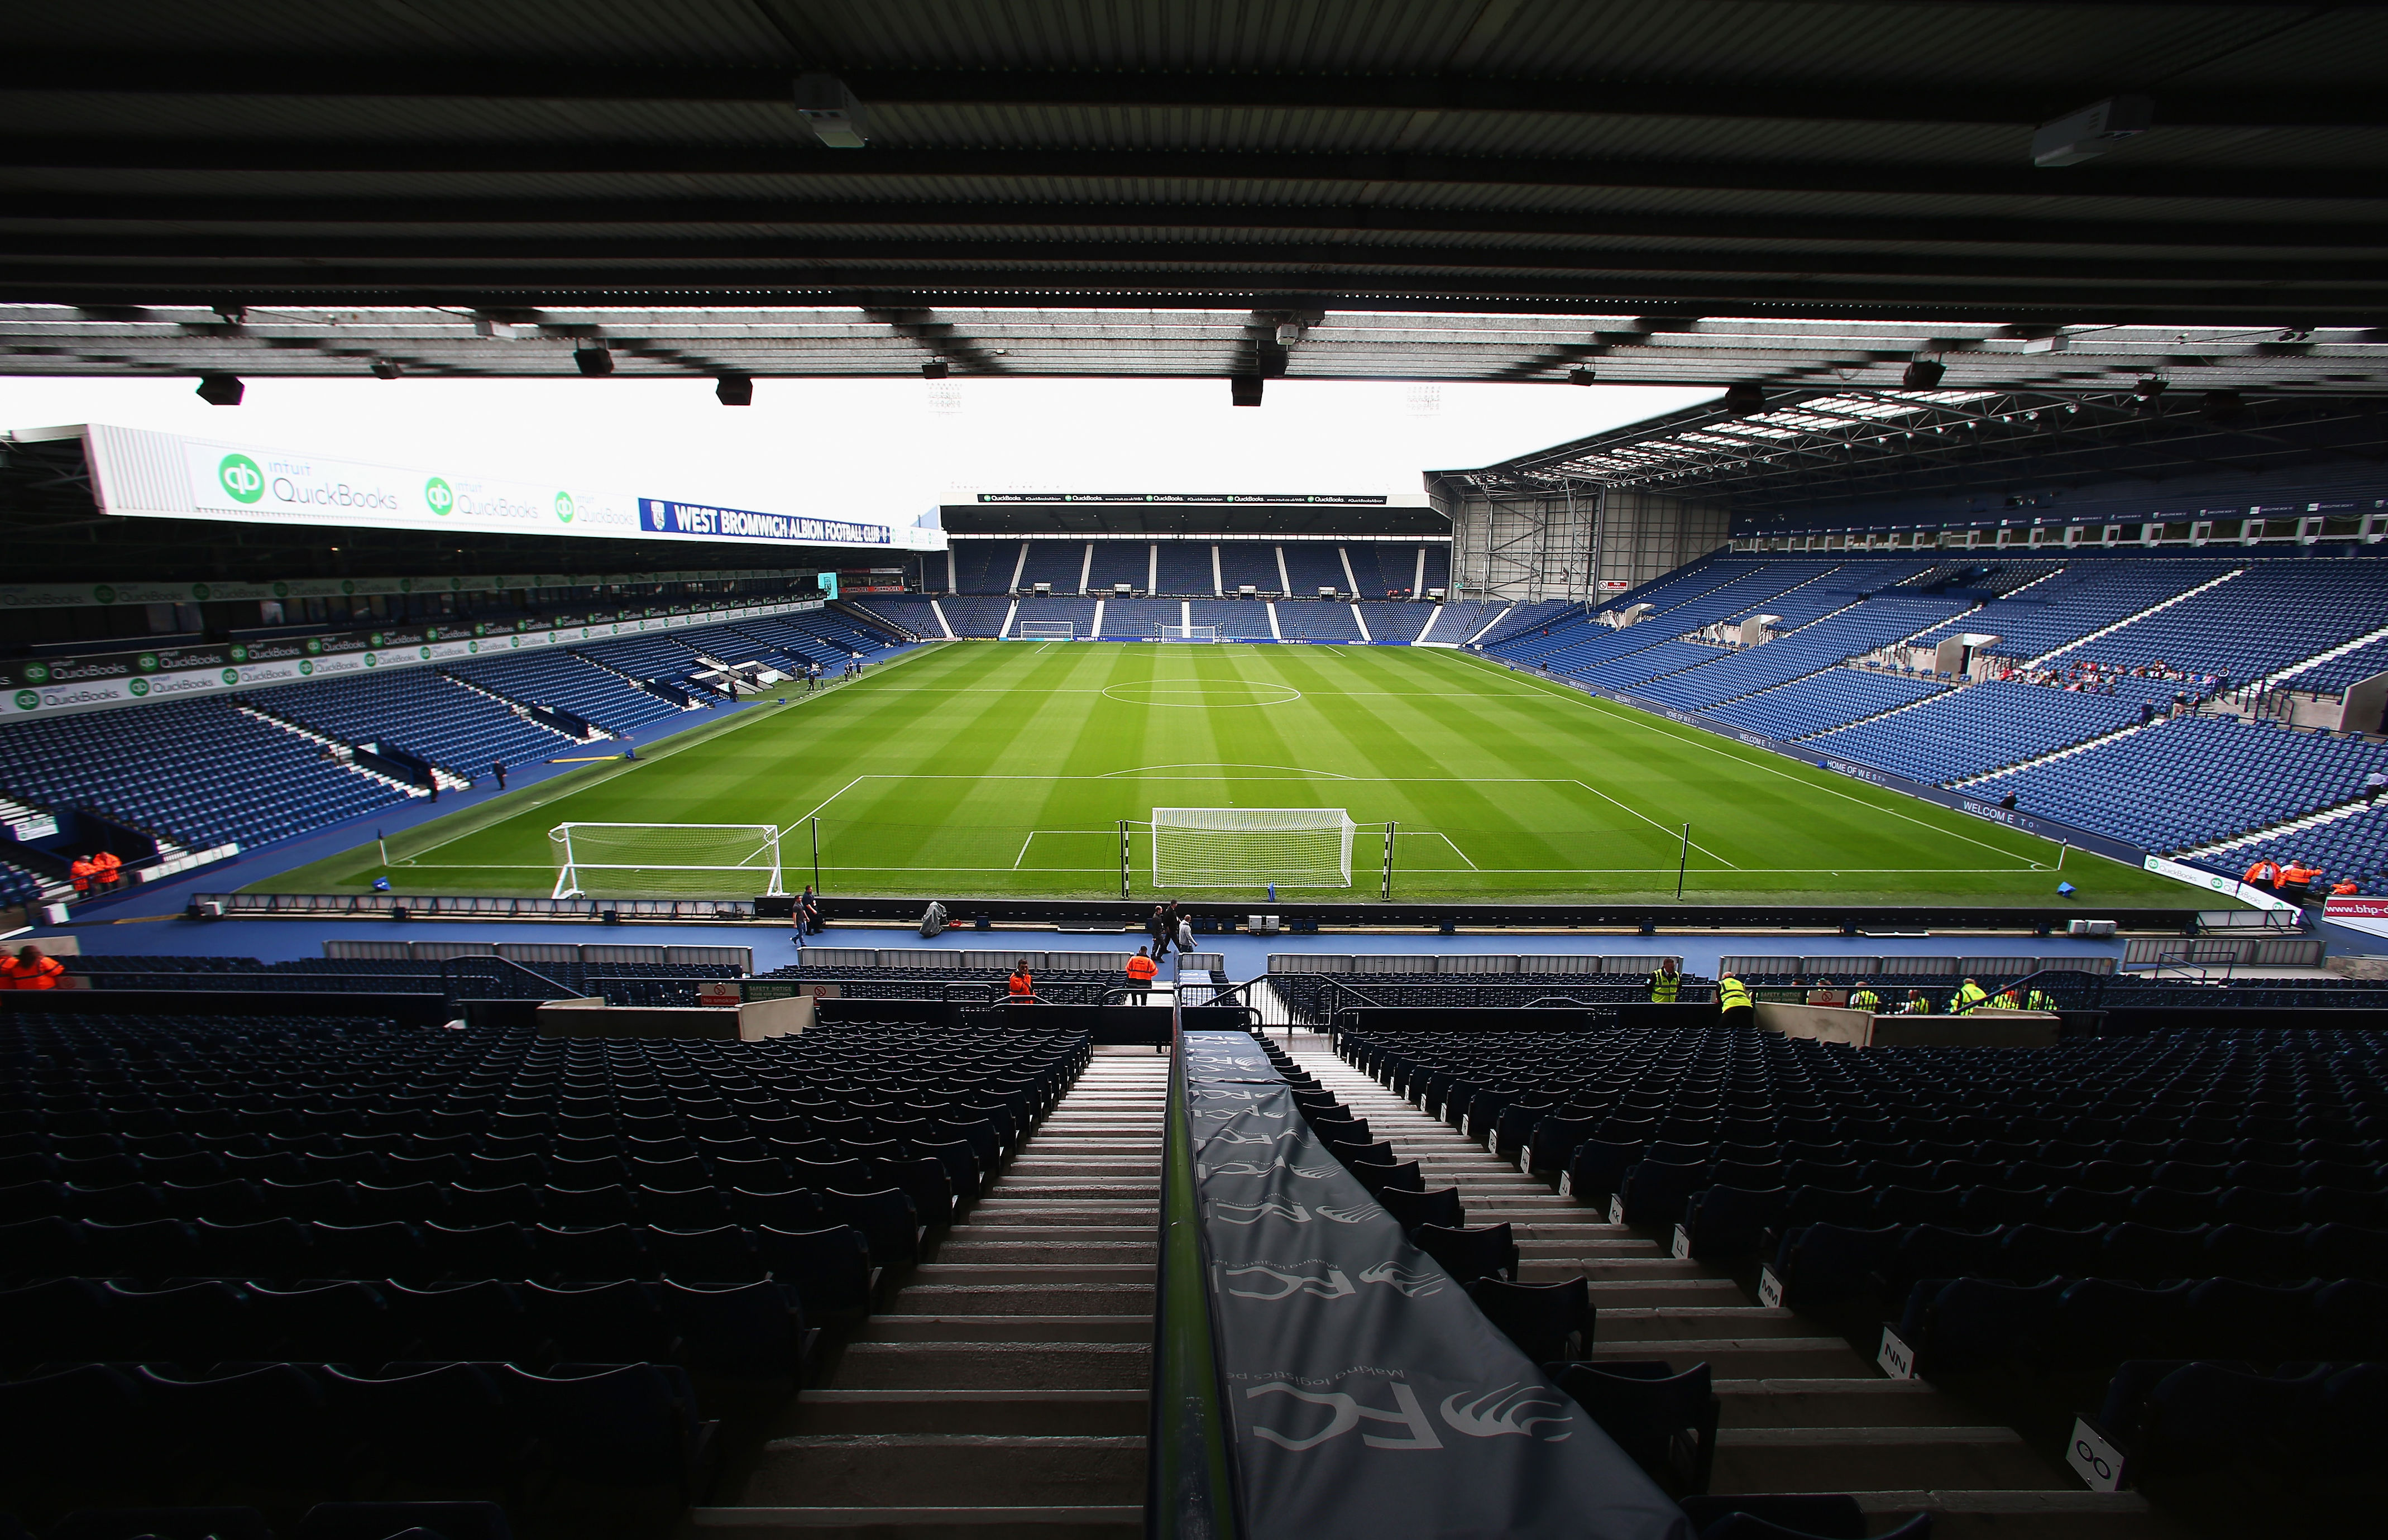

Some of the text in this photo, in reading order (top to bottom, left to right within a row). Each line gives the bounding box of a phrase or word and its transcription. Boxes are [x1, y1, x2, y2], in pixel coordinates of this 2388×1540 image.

[269, 460, 311, 476] intuit
[273, 477, 398, 509] QuickBooks
[458, 495, 538, 518] QuickBooks
[576, 506, 634, 525] QuickBooks
[673, 504, 718, 533] WEST
[720, 510, 788, 538] BROMWICH
[789, 518, 823, 540] ALBION
[825, 522, 863, 542] FOOTBALL
[863, 525, 880, 542] CLUB
[248, 646, 300, 659] QuickBooks
[160, 654, 222, 669] QuickBooks
[52, 663, 128, 680] QuickBooks
[241, 669, 291, 682] QuickBooks
[152, 678, 213, 693] QuickBooks
[45, 689, 119, 706] QuickBooks
[1615, 694, 1631, 704] WELCOME
[1666, 710, 1677, 719] HOME
[1740, 733, 1765, 747] WELCOME
[1827, 759, 1880, 781] HOME OF WEST
[1964, 800, 2033, 828] WELCOME TO
[2159, 865, 2196, 882] QuickBooks
[1523, 1156, 1528, 1166] HH
[1612, 1207, 1619, 1221] KK
[1677, 1240, 1684, 1256] LL
[1762, 1279, 1778, 1305] MM
[1884, 1343, 1906, 1374] NN
[1255, 1371, 1331, 1386] logistics
[1335, 1365, 1405, 1379] Making
[2076, 1439, 2111, 1480] OO
